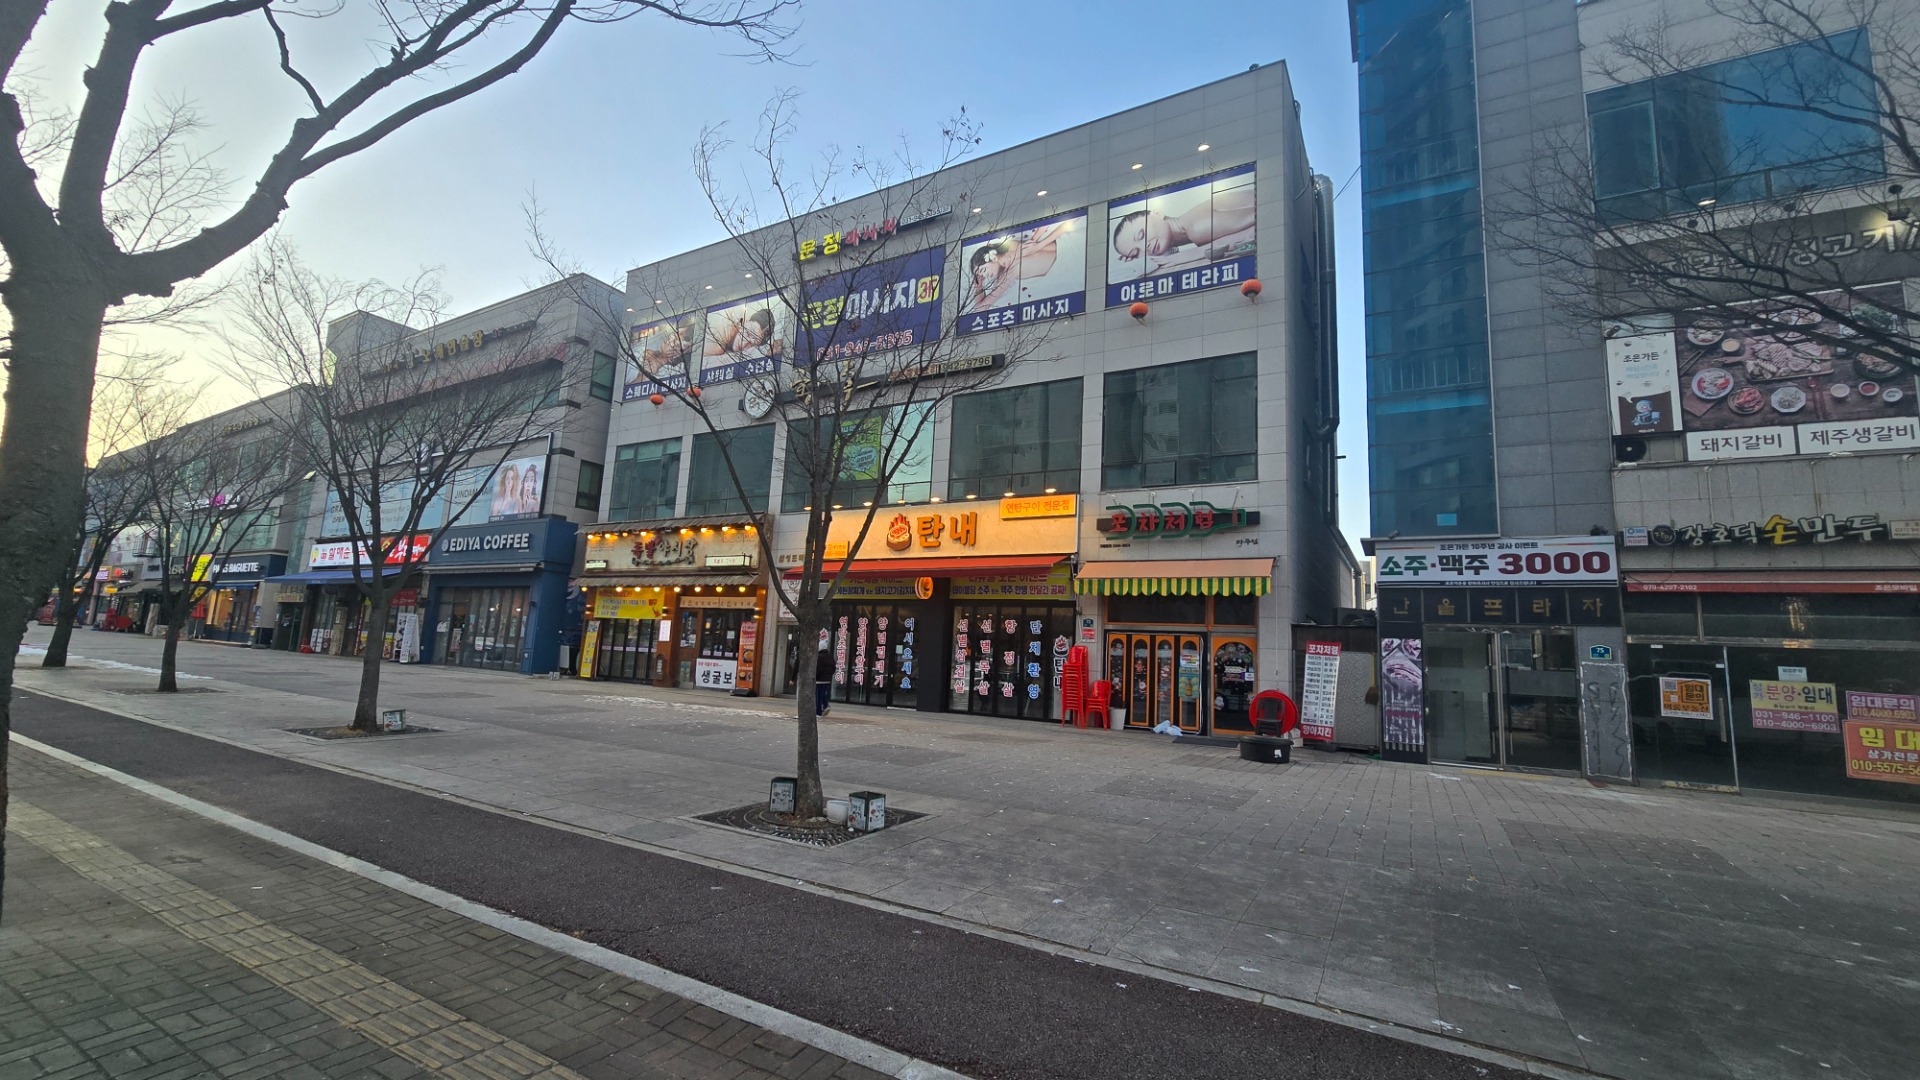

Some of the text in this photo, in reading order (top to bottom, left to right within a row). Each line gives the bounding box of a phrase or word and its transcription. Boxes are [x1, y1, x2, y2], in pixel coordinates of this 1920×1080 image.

[1121, 263, 1239, 302] 아로마 테라피
[971, 299, 1069, 331] 스포츠 마사지
[1623, 351, 1660, 363] 조은가든
[1700, 433, 1783, 453] 돼지갈비
[1810, 423, 1916, 446] 제주생갈비
[1005, 500, 1071, 514] 연탄구이 전문점
[917, 511, 978, 547] 탄내
[1108, 510, 1215, 533] 포차처럼
[450, 532, 530, 552] EDIYA COFFEE
[1439, 543, 1470, 551] 조은가든
[1497, 542, 1513, 550] 감사
[1514, 541, 1539, 549] 이벤트
[228, 562, 259, 573] BAGUETTE
[1497, 551, 1611, 575] 3000
[977, 584, 990, 594] 소주
[954, 618, 969, 693] 선별삼겹살
[978, 619, 993, 696] 선별목살
[1001, 619, 1018, 697] 항정살
[1027, 619, 1043, 699] 단체환영
[1308, 643, 1339, 655] 포차처럼
[1684, 683, 1705, 693] 임대
[1850, 695, 1915, 710] 임대문의
[1755, 710, 1835, 722] 031-946-1100
[1851, 707, 1917, 720] 010.4000.6903
[1756, 718, 1837, 731] 010-4000-6903
